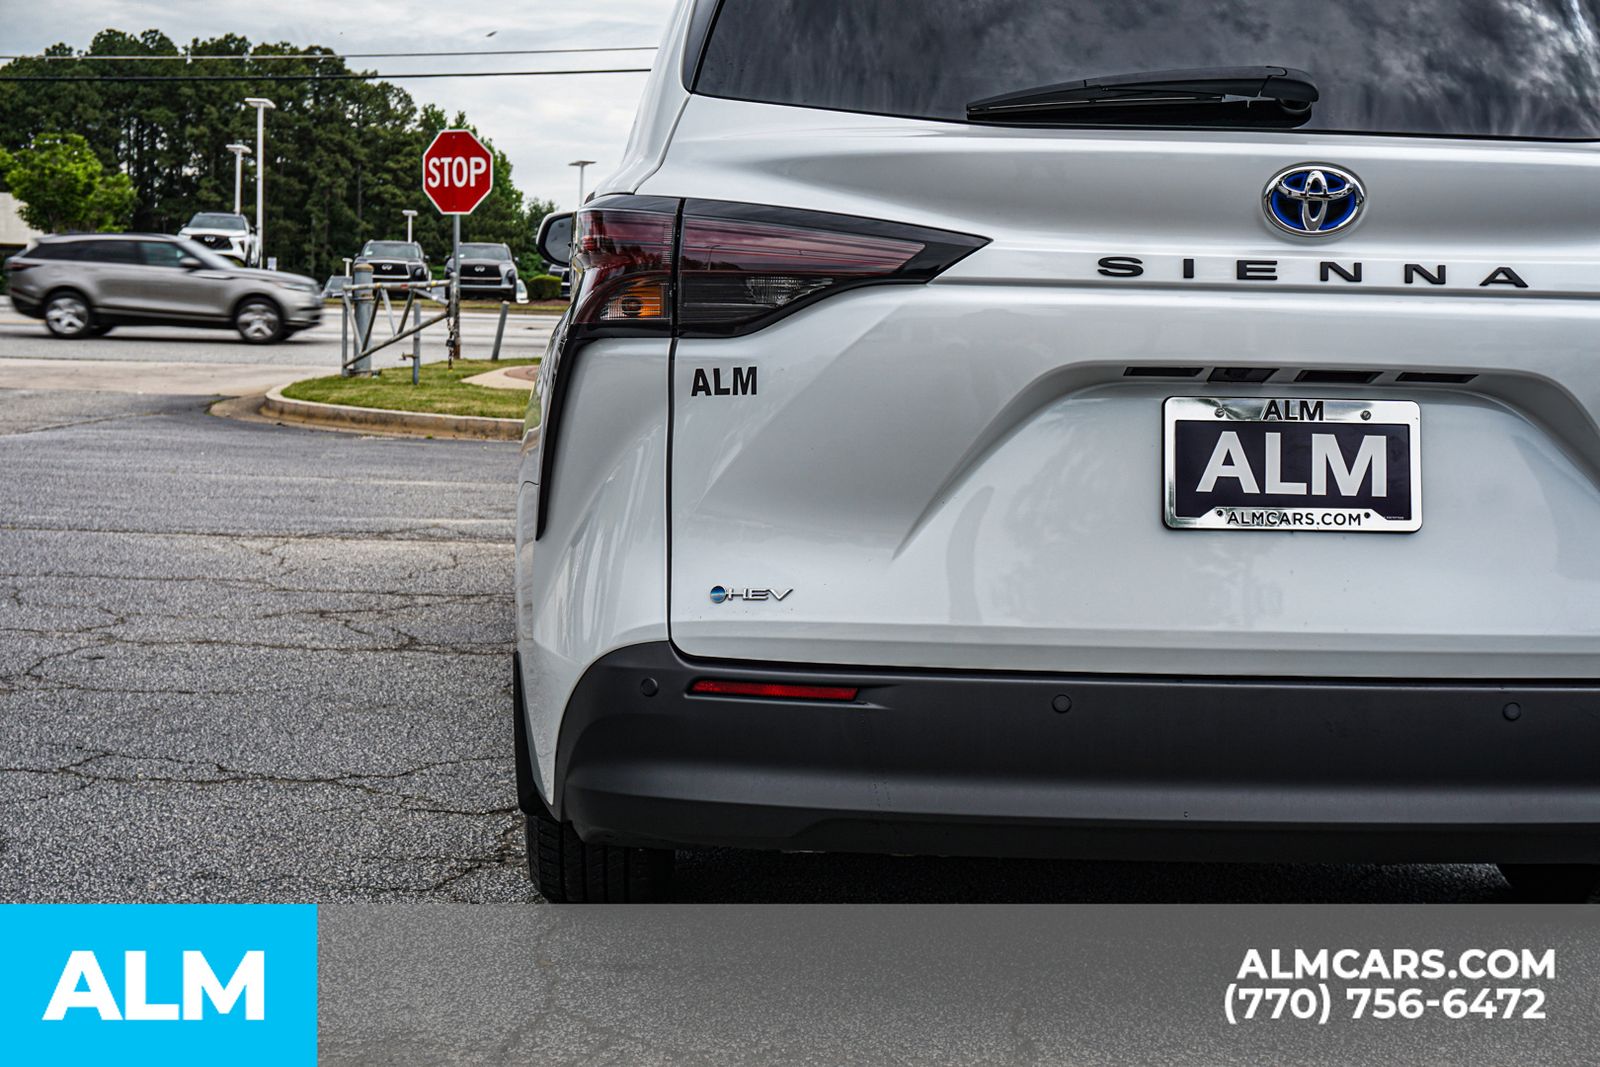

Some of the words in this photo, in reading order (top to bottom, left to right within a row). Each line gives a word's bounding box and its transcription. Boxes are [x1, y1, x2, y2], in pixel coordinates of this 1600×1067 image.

[427, 156, 487, 188] STOP
[1097, 256, 1529, 288] SIENNA
[691, 366, 758, 397] ALM
[1263, 399, 1324, 421] ALM
[1195, 431, 1387, 498] ALM
[1226, 511, 1362, 527] ALMCARS.COM
[725, 586, 794, 601] HEV
